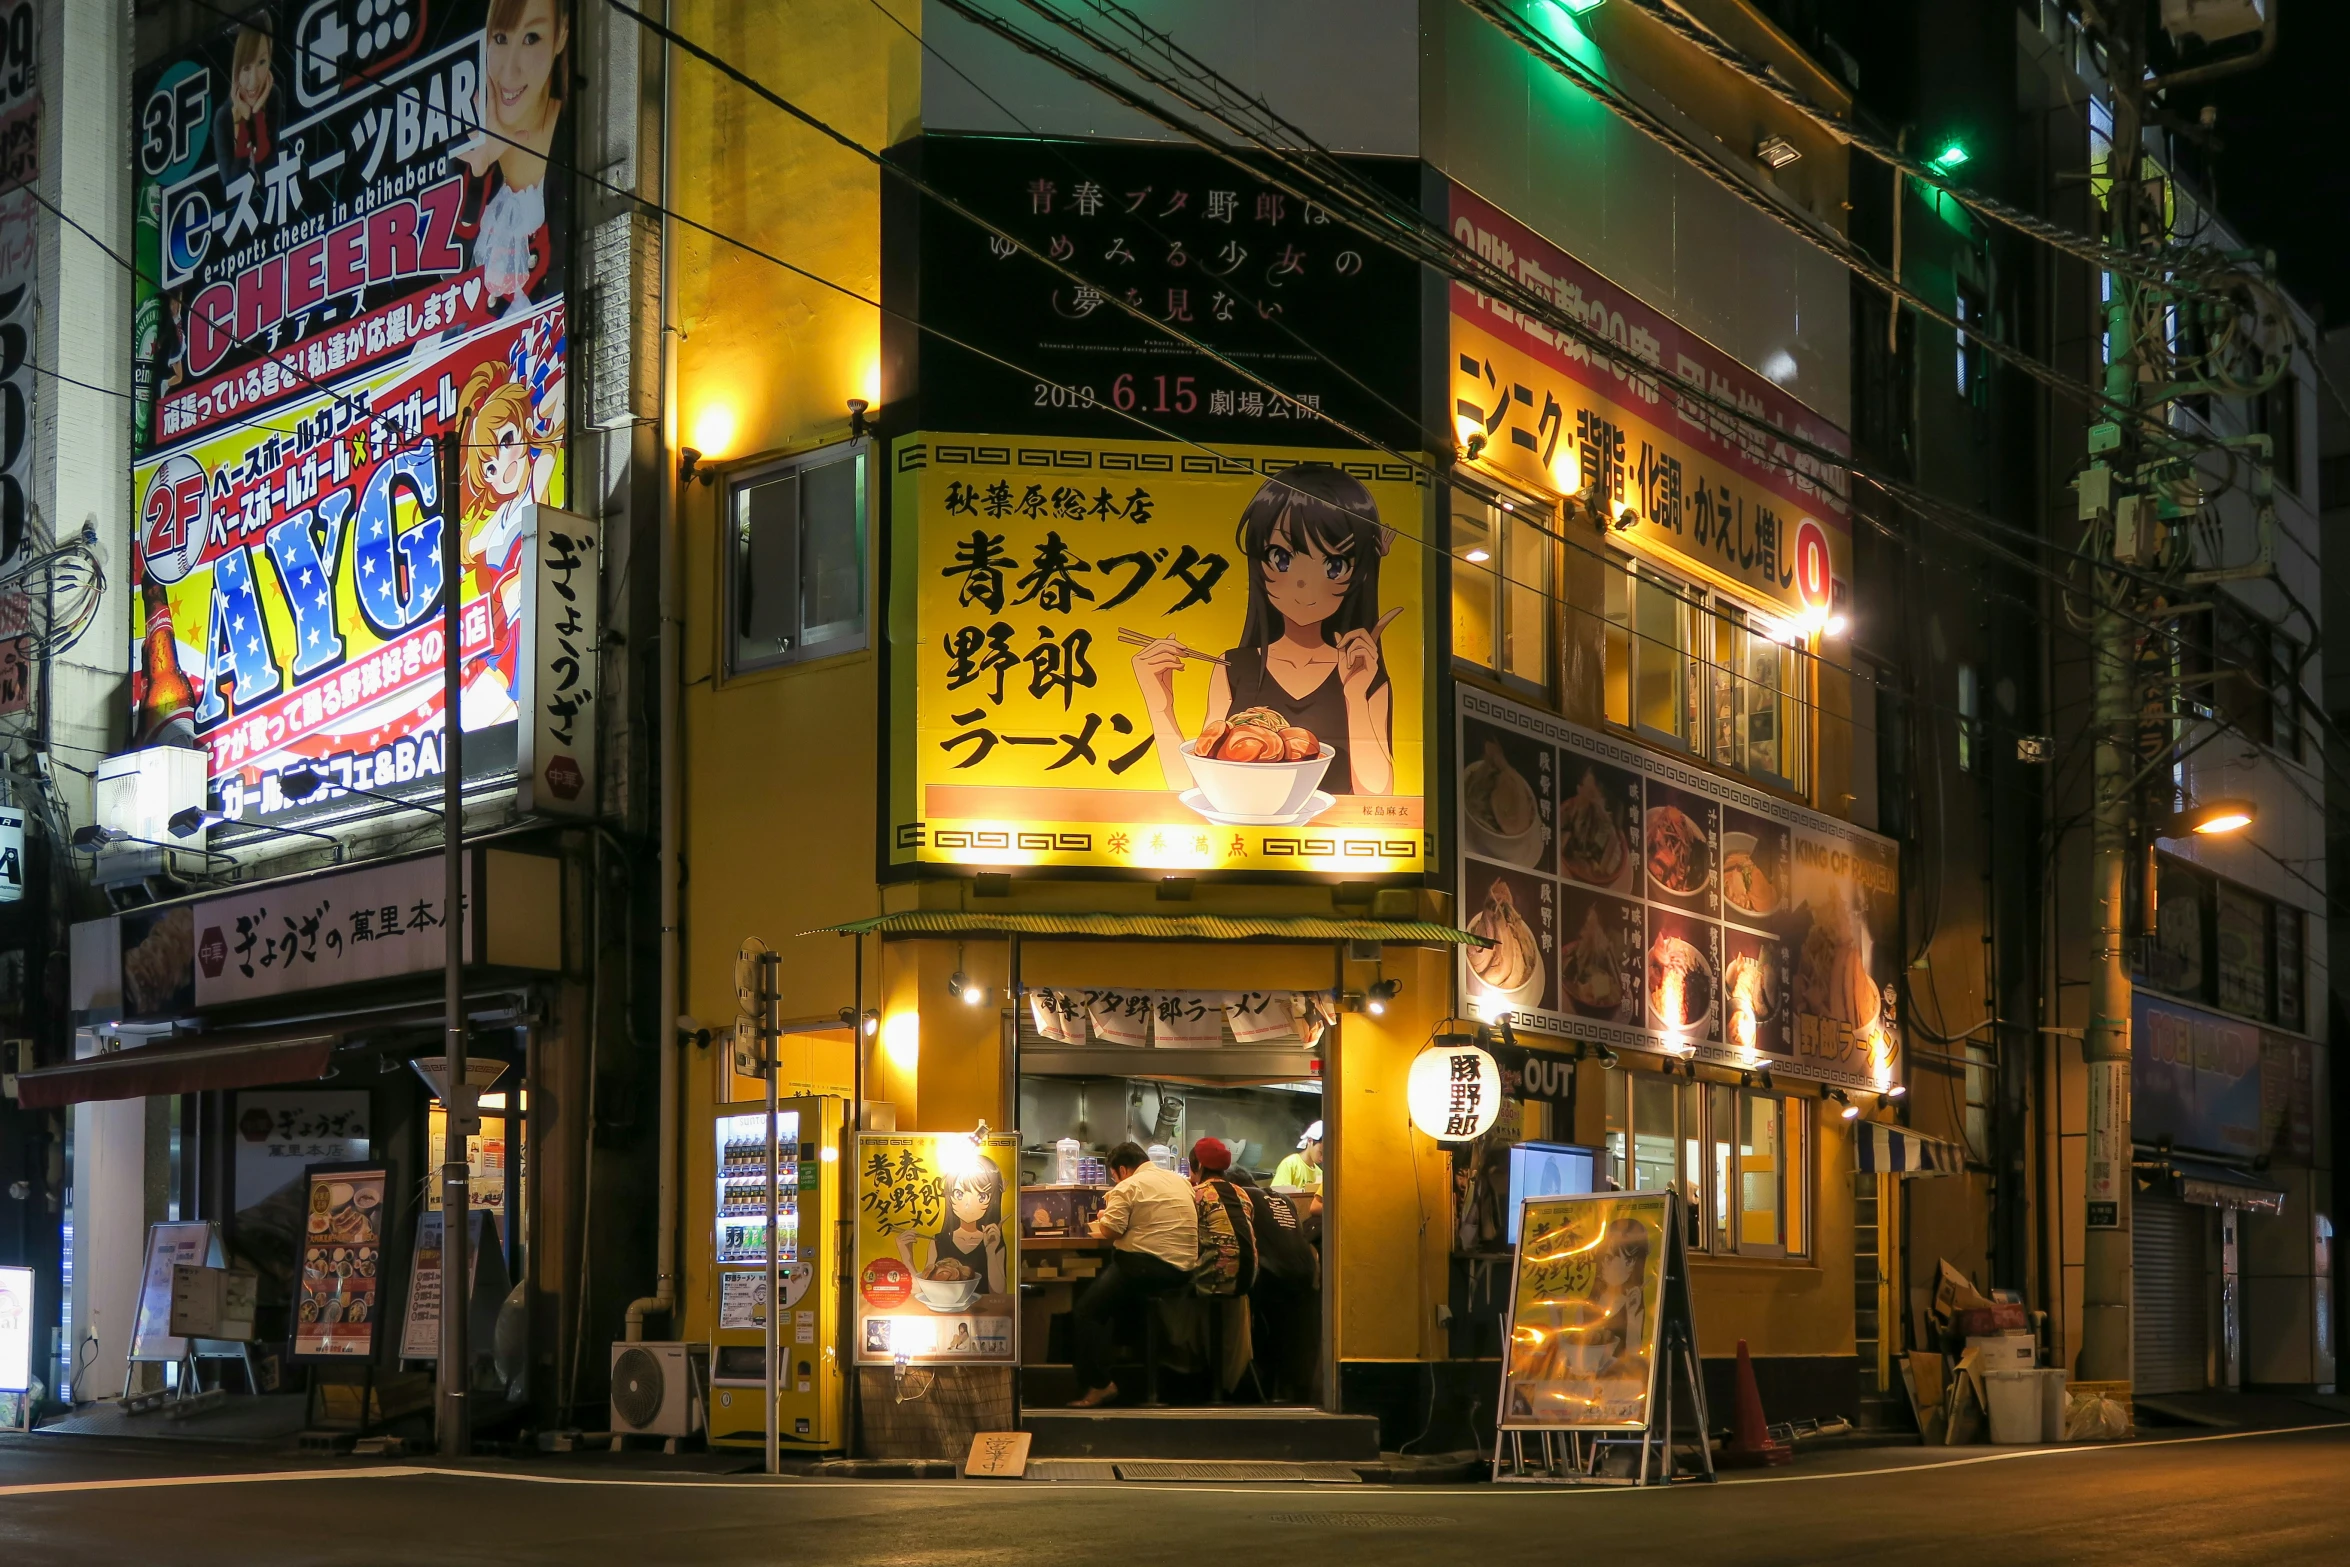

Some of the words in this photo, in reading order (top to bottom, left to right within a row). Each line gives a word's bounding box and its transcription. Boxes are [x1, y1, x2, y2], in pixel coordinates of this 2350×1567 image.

[142, 68, 211, 176] 3F
[166, 60, 481, 277] e-スポーツBAR
[203, 239, 268, 284] e-sports
[272, 212, 326, 258] cheerz
[331, 201, 350, 229] in
[354, 155, 447, 217] akihabara
[187, 174, 465, 377] CHEERZ
[988, 232, 1364, 287] ゆめみる少女の
[267, 288, 368, 354] チアース
[1037, 342, 1075, 350] Abnormal
[1076, 344, 1120, 352] experiences
[1122, 345, 1148, 354] during
[1112, 372, 1199, 415] 6.15
[1208, 388, 1322, 421] 劇場公開
[212, 386, 373, 502] ベースボールカフェ
[146, 470, 209, 558] 2F
[944, 478, 1156, 525] 秋葉原総本店
[196, 438, 446, 727] AYG
[941, 529, 1231, 617] 青春ブタ
[544, 529, 596, 747] ぎょうざ
[942, 620, 1099, 713] 野郎
[939, 706, 1156, 776] ラーメン
[1362, 804, 1409, 818] 桜島麻衣
[1628, 780, 1641, 872] 味噌野郎
[1107, 831, 1248, 858] 栄養満点
[1707, 808, 1719, 912] 汁無し野郎
[1795, 837, 1829, 872] KING
[1830, 854, 1850, 876] OF
[1851, 856, 1896, 896] RAMEN
[234, 899, 343, 979] ぎょうざの
[350, 893, 469, 946] 萬里本
[1800, 1013, 1900, 1070] 野郎ラーメン
[2147, 1007, 2193, 1068] TOEI
[1443, 1054, 1483, 1137] 豚野郎
[1523, 1057, 1574, 1098] OUT
[268, 1143, 345, 1158] 萬里本店
[277, 1107, 365, 1141] ぎょうざの
[860, 1175, 947, 1219] ブタ野郎
[864, 1148, 929, 1190] 青春
[876, 1206, 942, 1238] ラーメン
[1532, 1273, 1593, 1299] ラーメン
